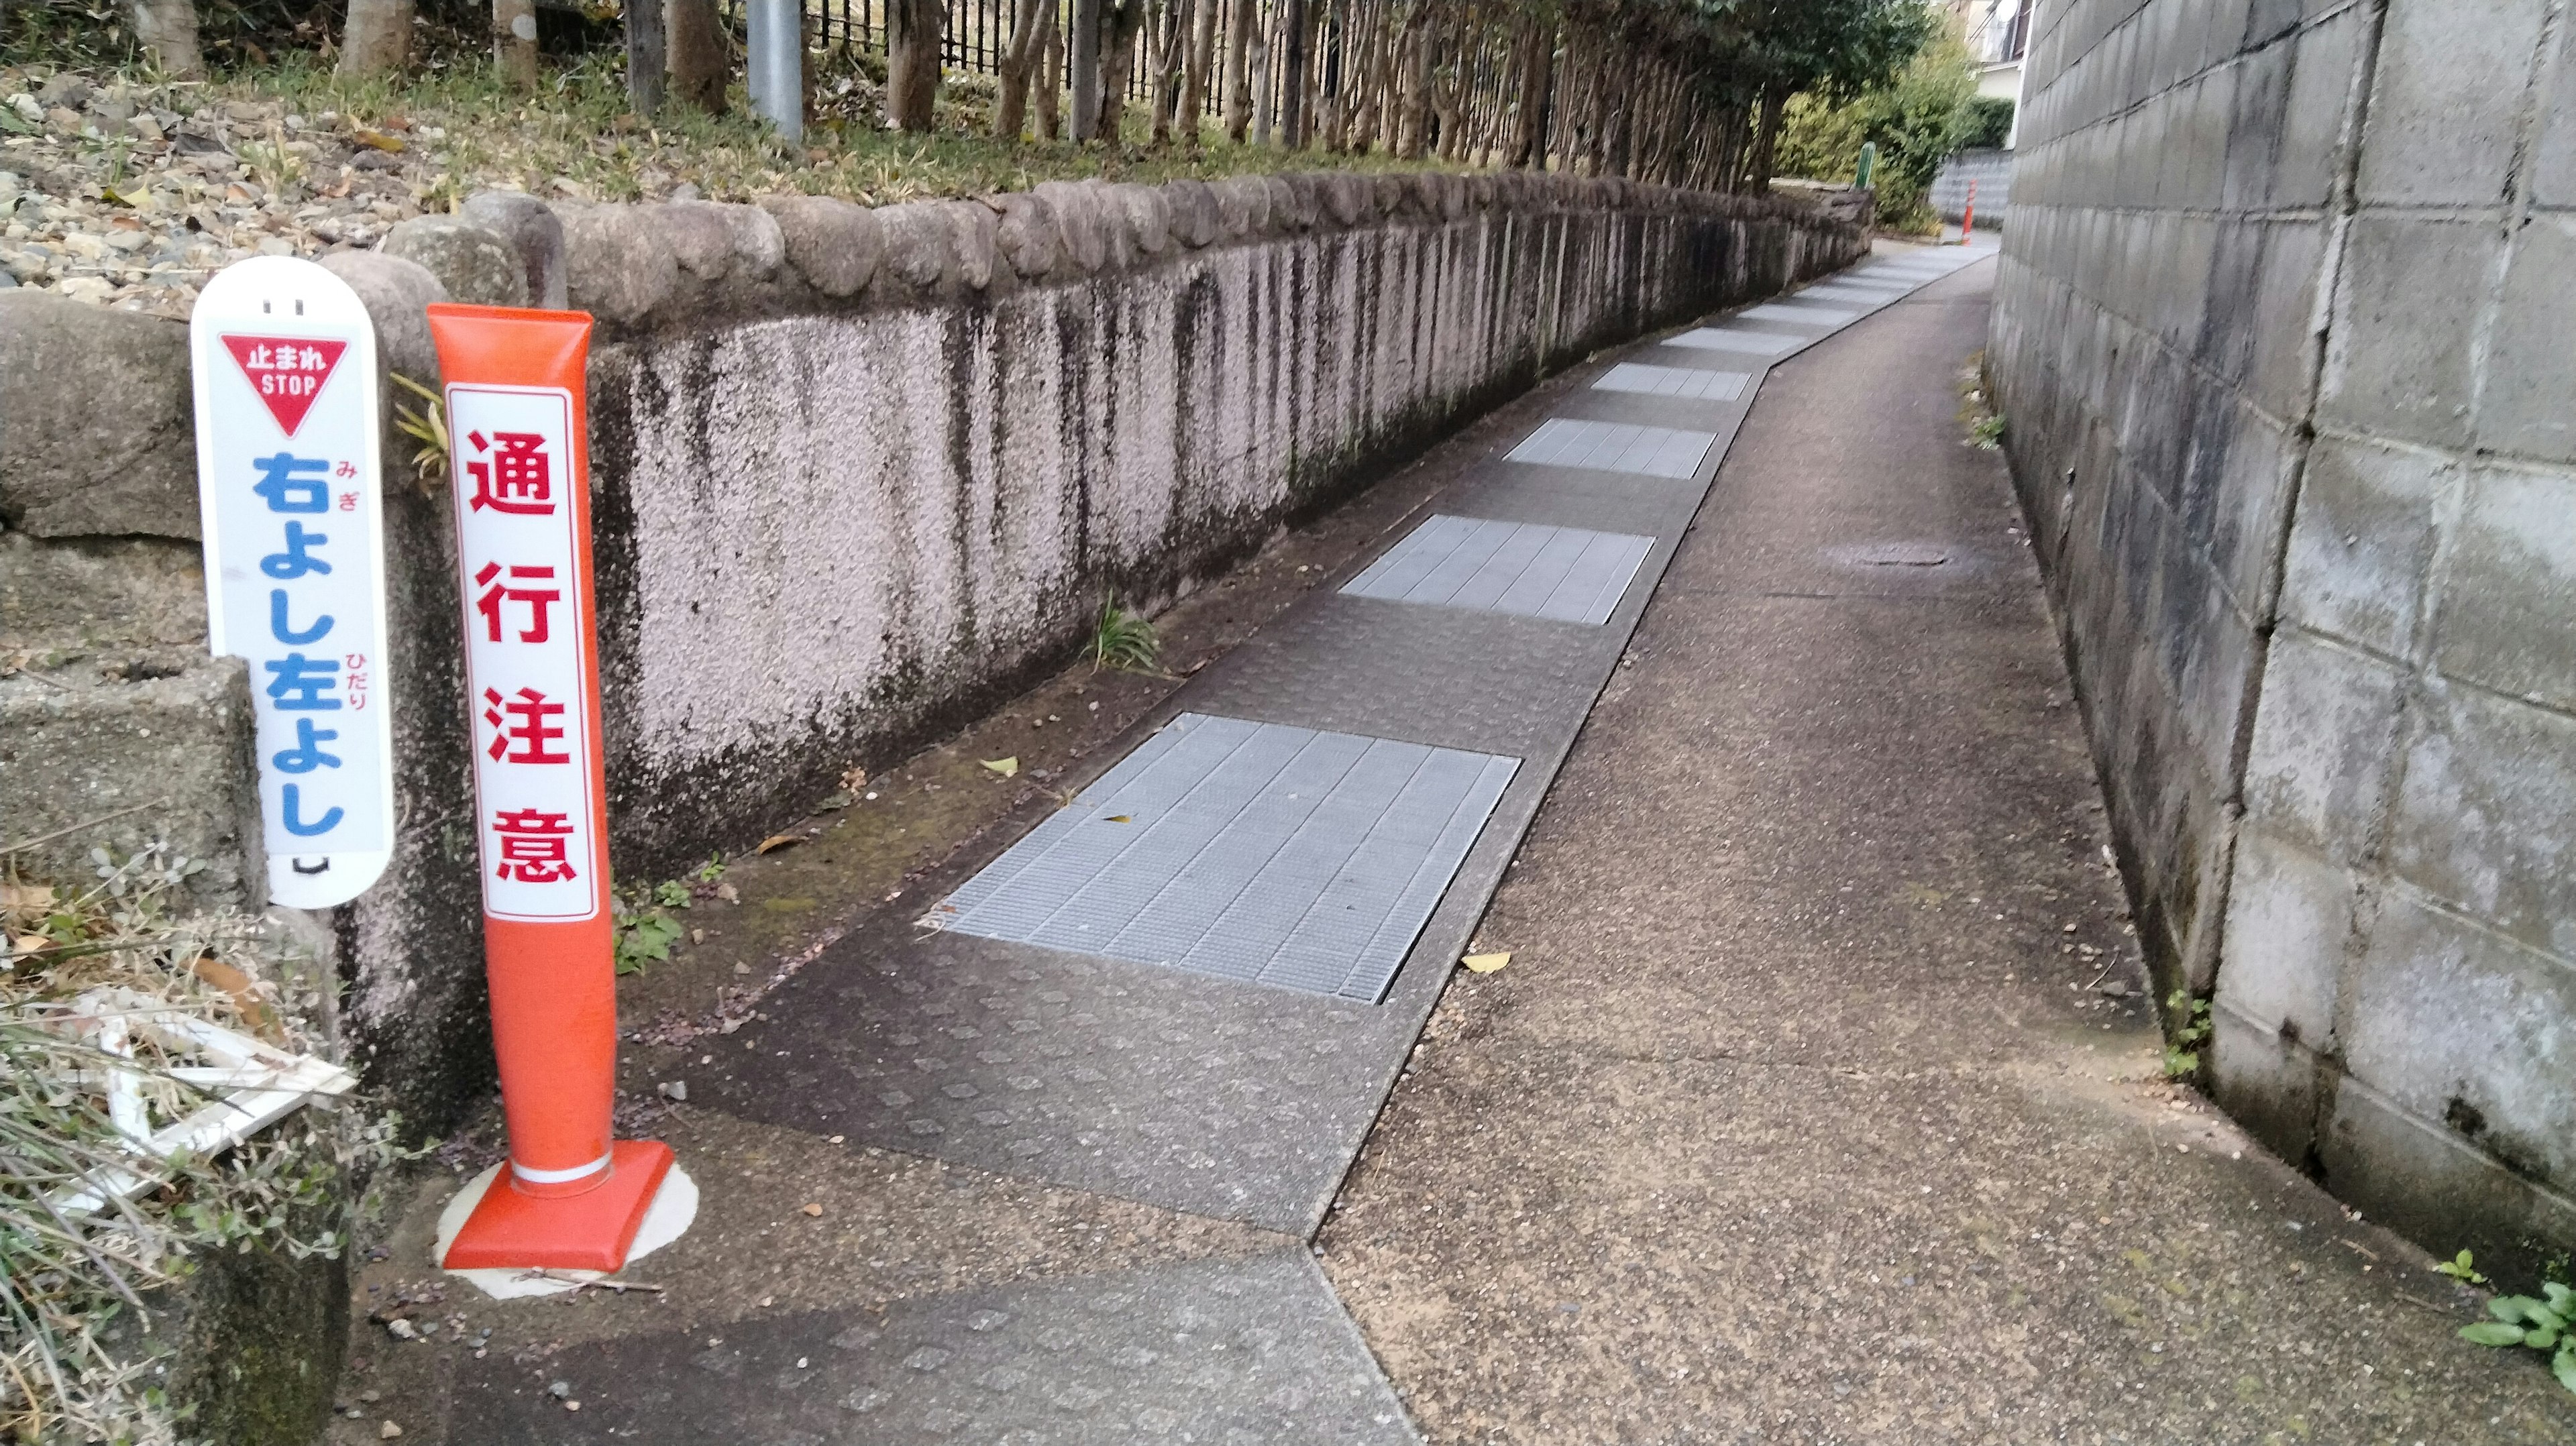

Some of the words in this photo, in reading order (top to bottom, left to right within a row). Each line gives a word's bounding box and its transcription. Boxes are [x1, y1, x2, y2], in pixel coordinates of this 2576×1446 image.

[246, 343, 327, 370] 止まれ
[261, 374, 317, 396] STOP
[336, 460, 360, 512] みぎ
[252, 451, 345, 836] 右よし左よし
[466, 429, 578, 883] 通行注意
[345, 653, 368, 711] ひだり
